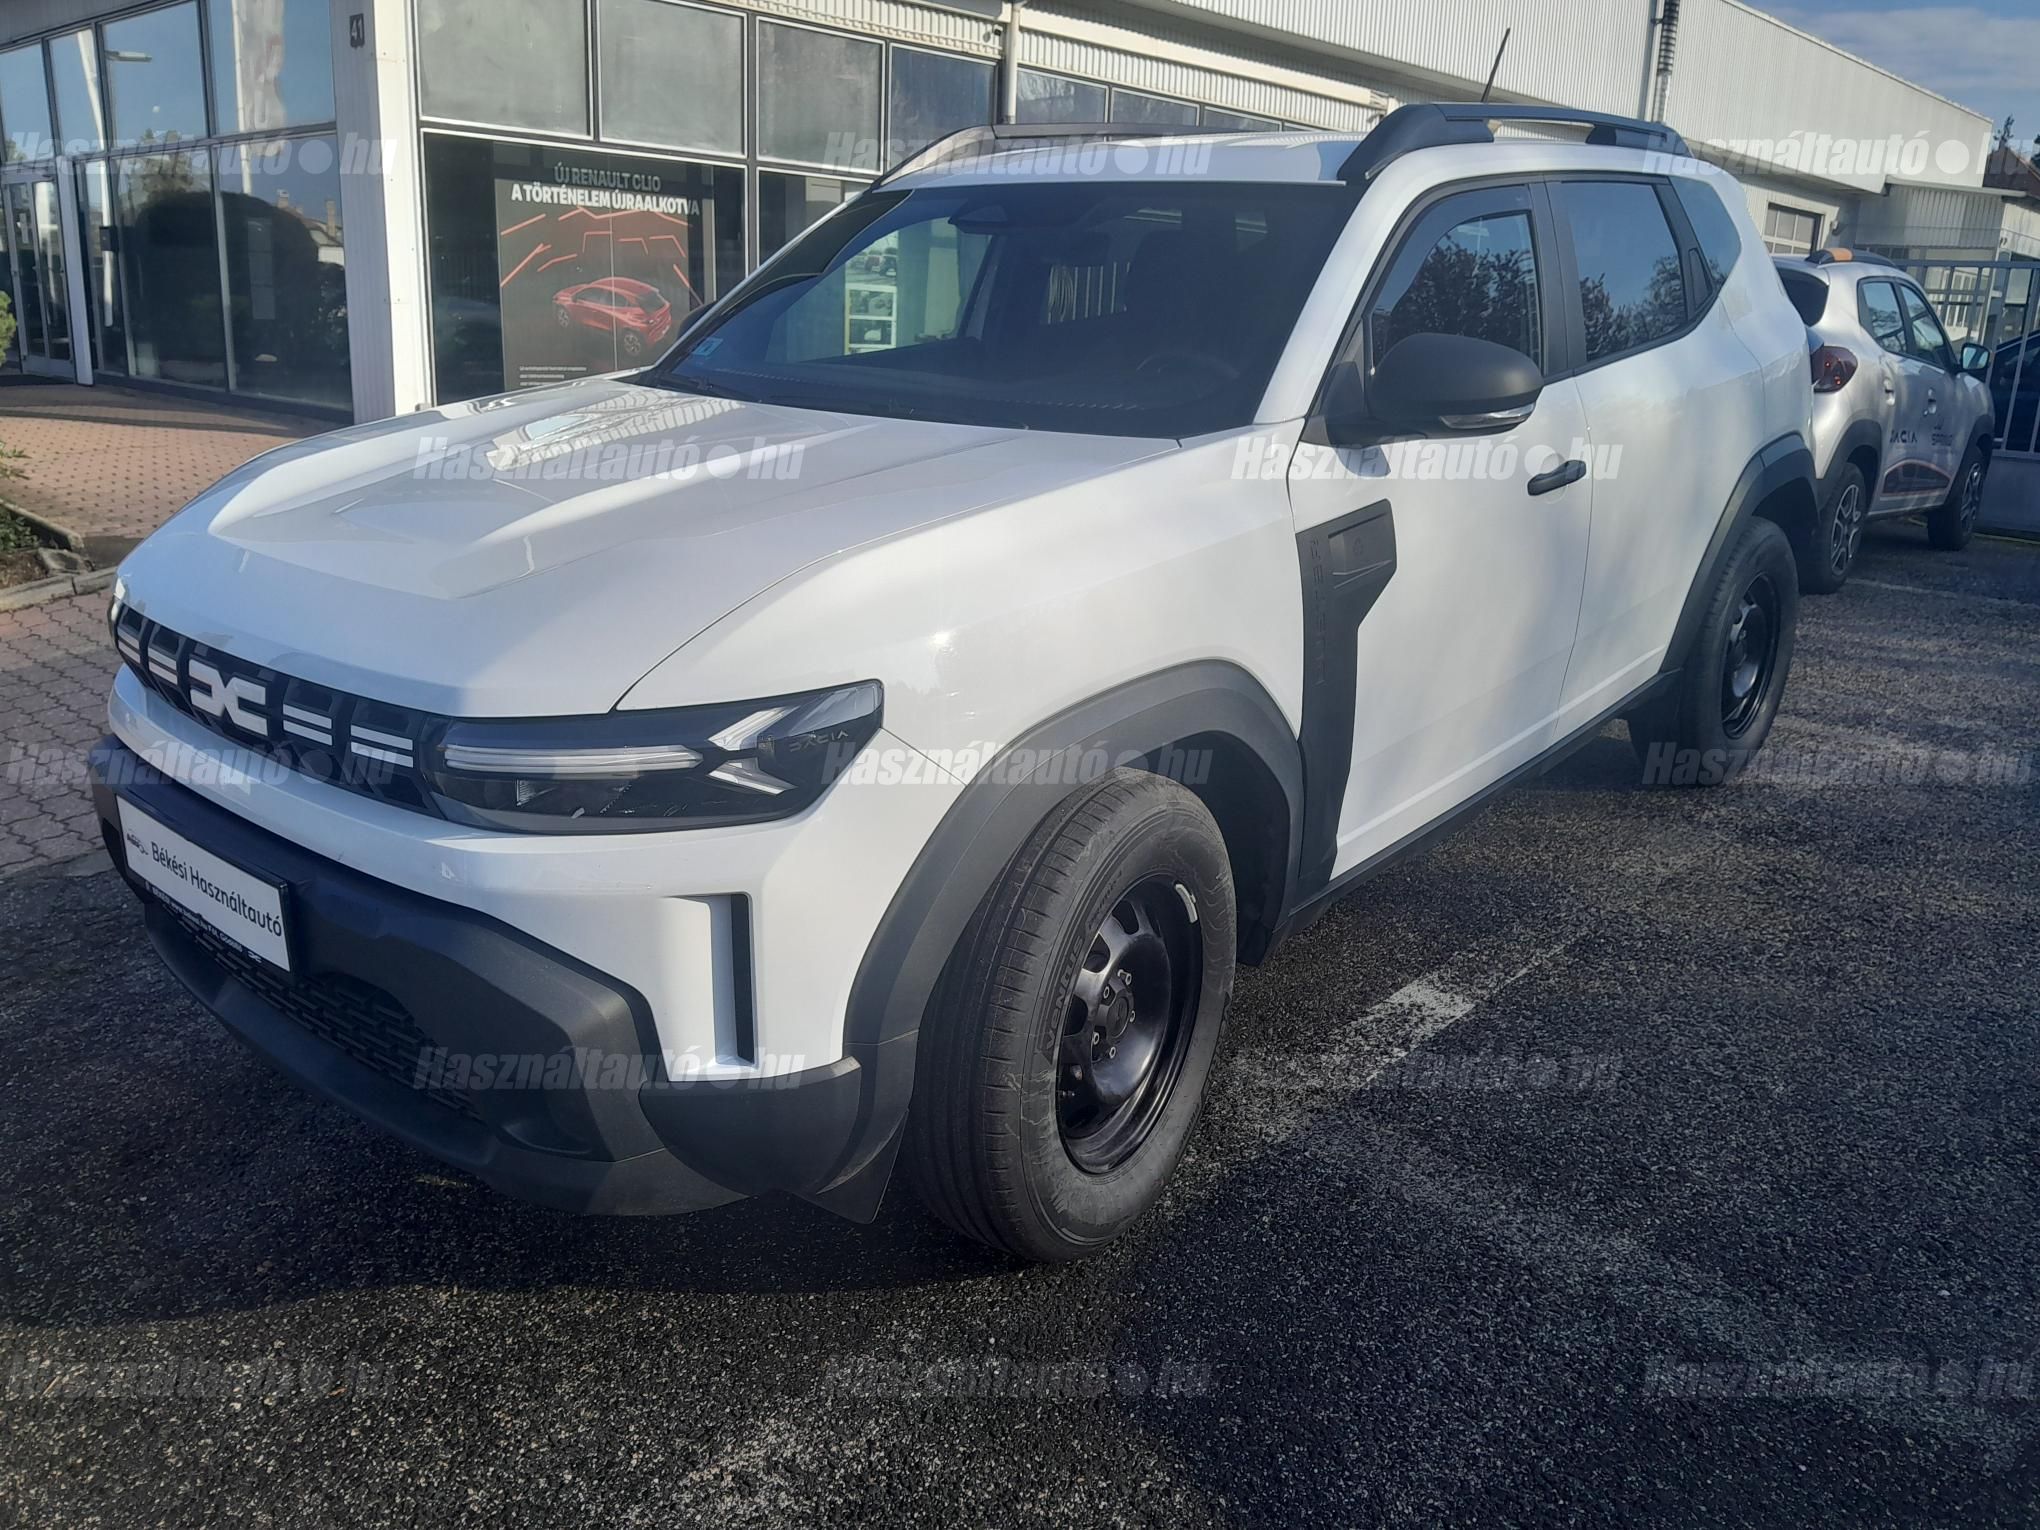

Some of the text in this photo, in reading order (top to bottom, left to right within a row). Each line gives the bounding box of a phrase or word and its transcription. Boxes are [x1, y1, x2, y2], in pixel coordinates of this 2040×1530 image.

[554, 162, 662, 193] ÚJ RENAULT CLIO
[511, 181, 700, 216] A TÖRTÉNELEM ÚJRAALKOTVA
[151, 840, 188, 882] Békési
[190, 866, 283, 937] Használtautó
